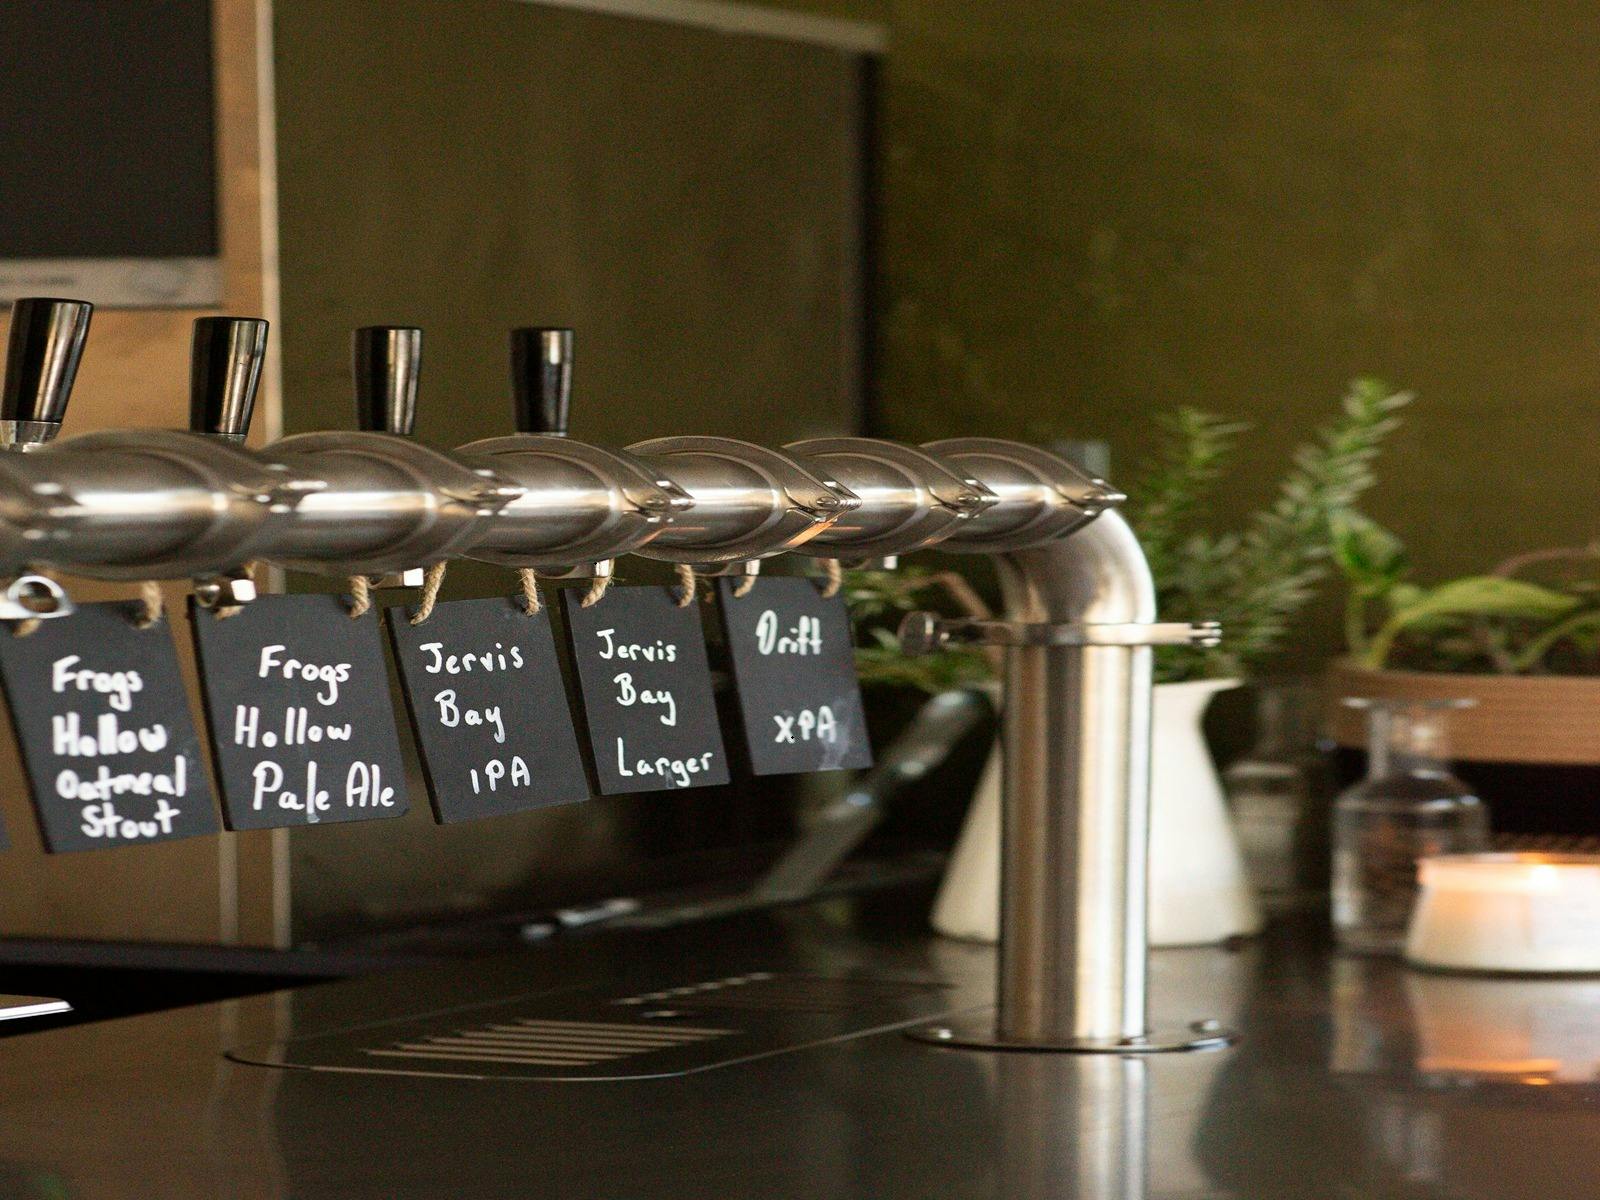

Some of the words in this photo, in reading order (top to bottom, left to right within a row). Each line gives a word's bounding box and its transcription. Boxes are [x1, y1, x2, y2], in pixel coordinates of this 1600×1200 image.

[596, 628, 677, 663] Jervis
[755, 609, 822, 656] Drift
[258, 644, 352, 706] Frogs
[419, 642, 524, 675] Jervis
[52, 654, 144, 711] Frogs
[612, 672, 677, 726] Bay
[52, 711, 168, 757] Hollow
[234, 705, 352, 748] Hollow
[434, 688, 505, 744] Bay
[55, 754, 187, 801] Oatmeal
[616, 736, 714, 787] Larger
[252, 760, 331, 811] Pale
[345, 760, 395, 808] Ale
[80, 799, 181, 838] Stout
